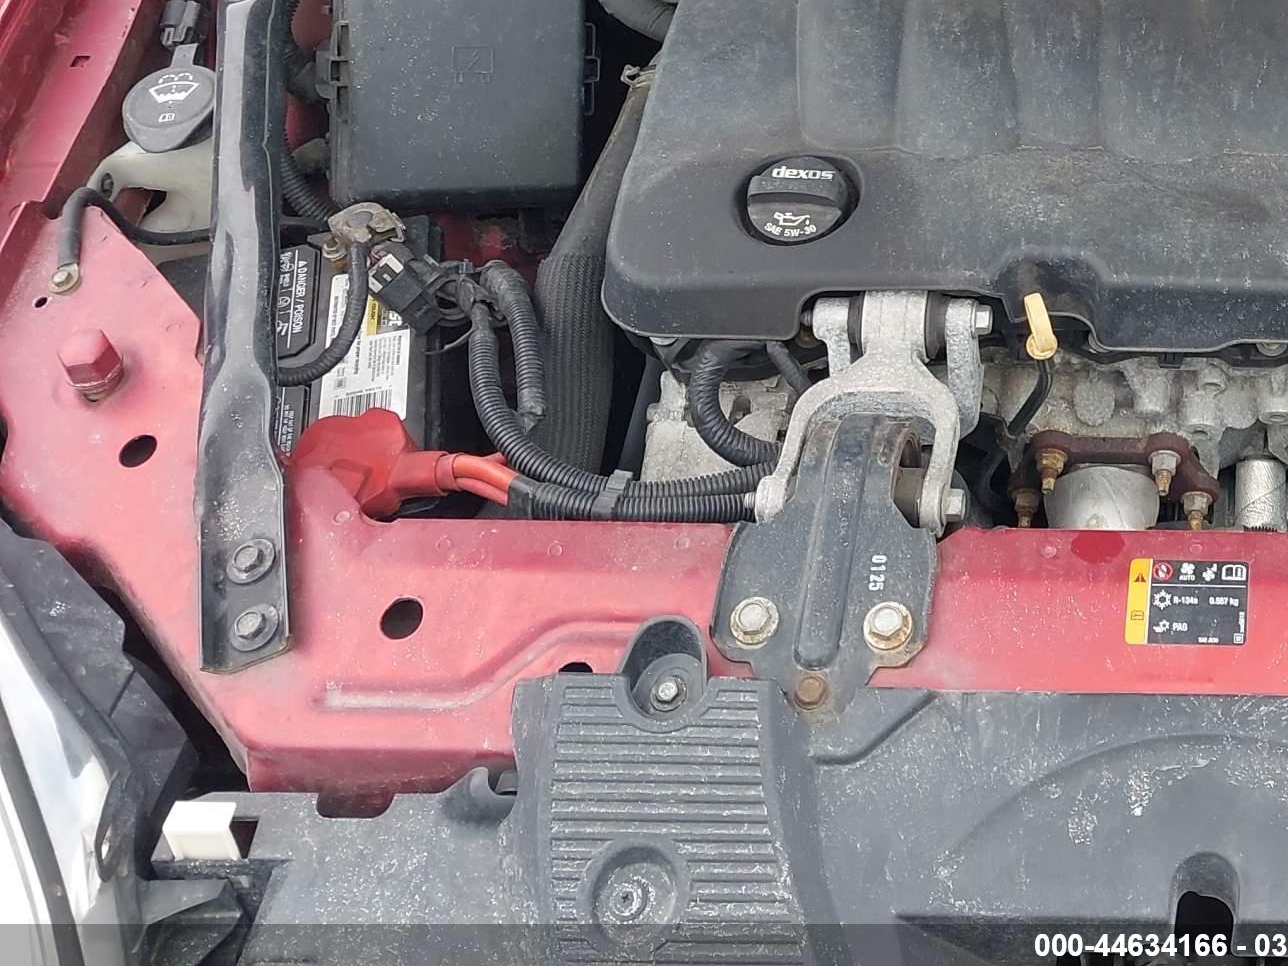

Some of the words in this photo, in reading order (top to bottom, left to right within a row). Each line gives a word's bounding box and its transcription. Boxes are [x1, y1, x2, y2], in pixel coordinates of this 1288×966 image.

[771, 166, 836, 180] dexos
[764, 222, 783, 236] SAE
[784, 224, 817, 237] 5W-30
[295, 267, 308, 298] DANGER
[291, 303, 305, 332] POISON
[869, 554, 887, 591] 0125
[1173, 596, 1198, 604] R-134a
[1172, 622, 1188, 631] PAG
